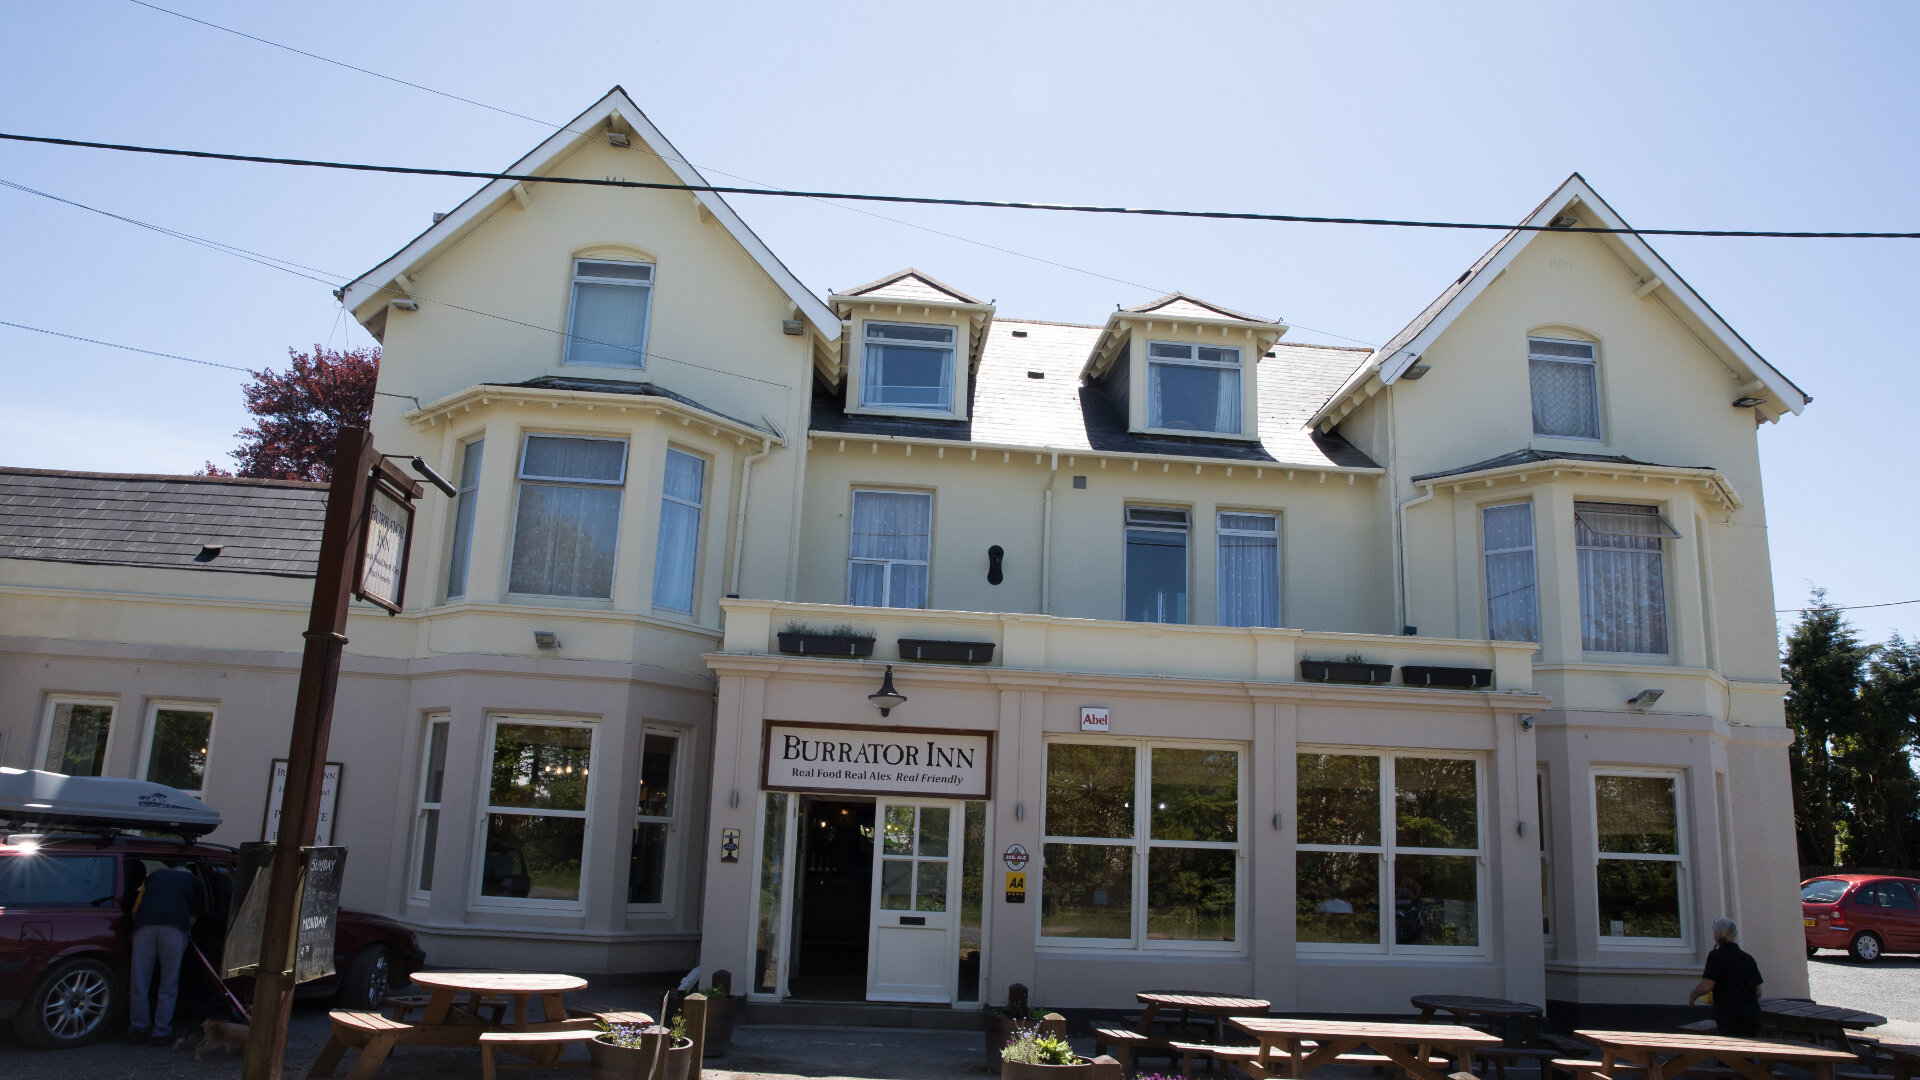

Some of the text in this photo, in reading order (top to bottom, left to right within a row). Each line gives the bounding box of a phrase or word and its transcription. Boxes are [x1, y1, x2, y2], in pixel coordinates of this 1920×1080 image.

[371, 505, 405, 540] BURRATOR
[377, 531, 391, 552] INN
[1083, 713, 1108, 725] Abel
[782, 734, 975, 769] BURRATOR INN
[791, 767, 964, 786] Real Food Real Ales Real Friendly
[310, 859, 336, 873] SUNDAY
[1009, 877, 1024, 889] AA
[302, 915, 328, 931] MONDAY
